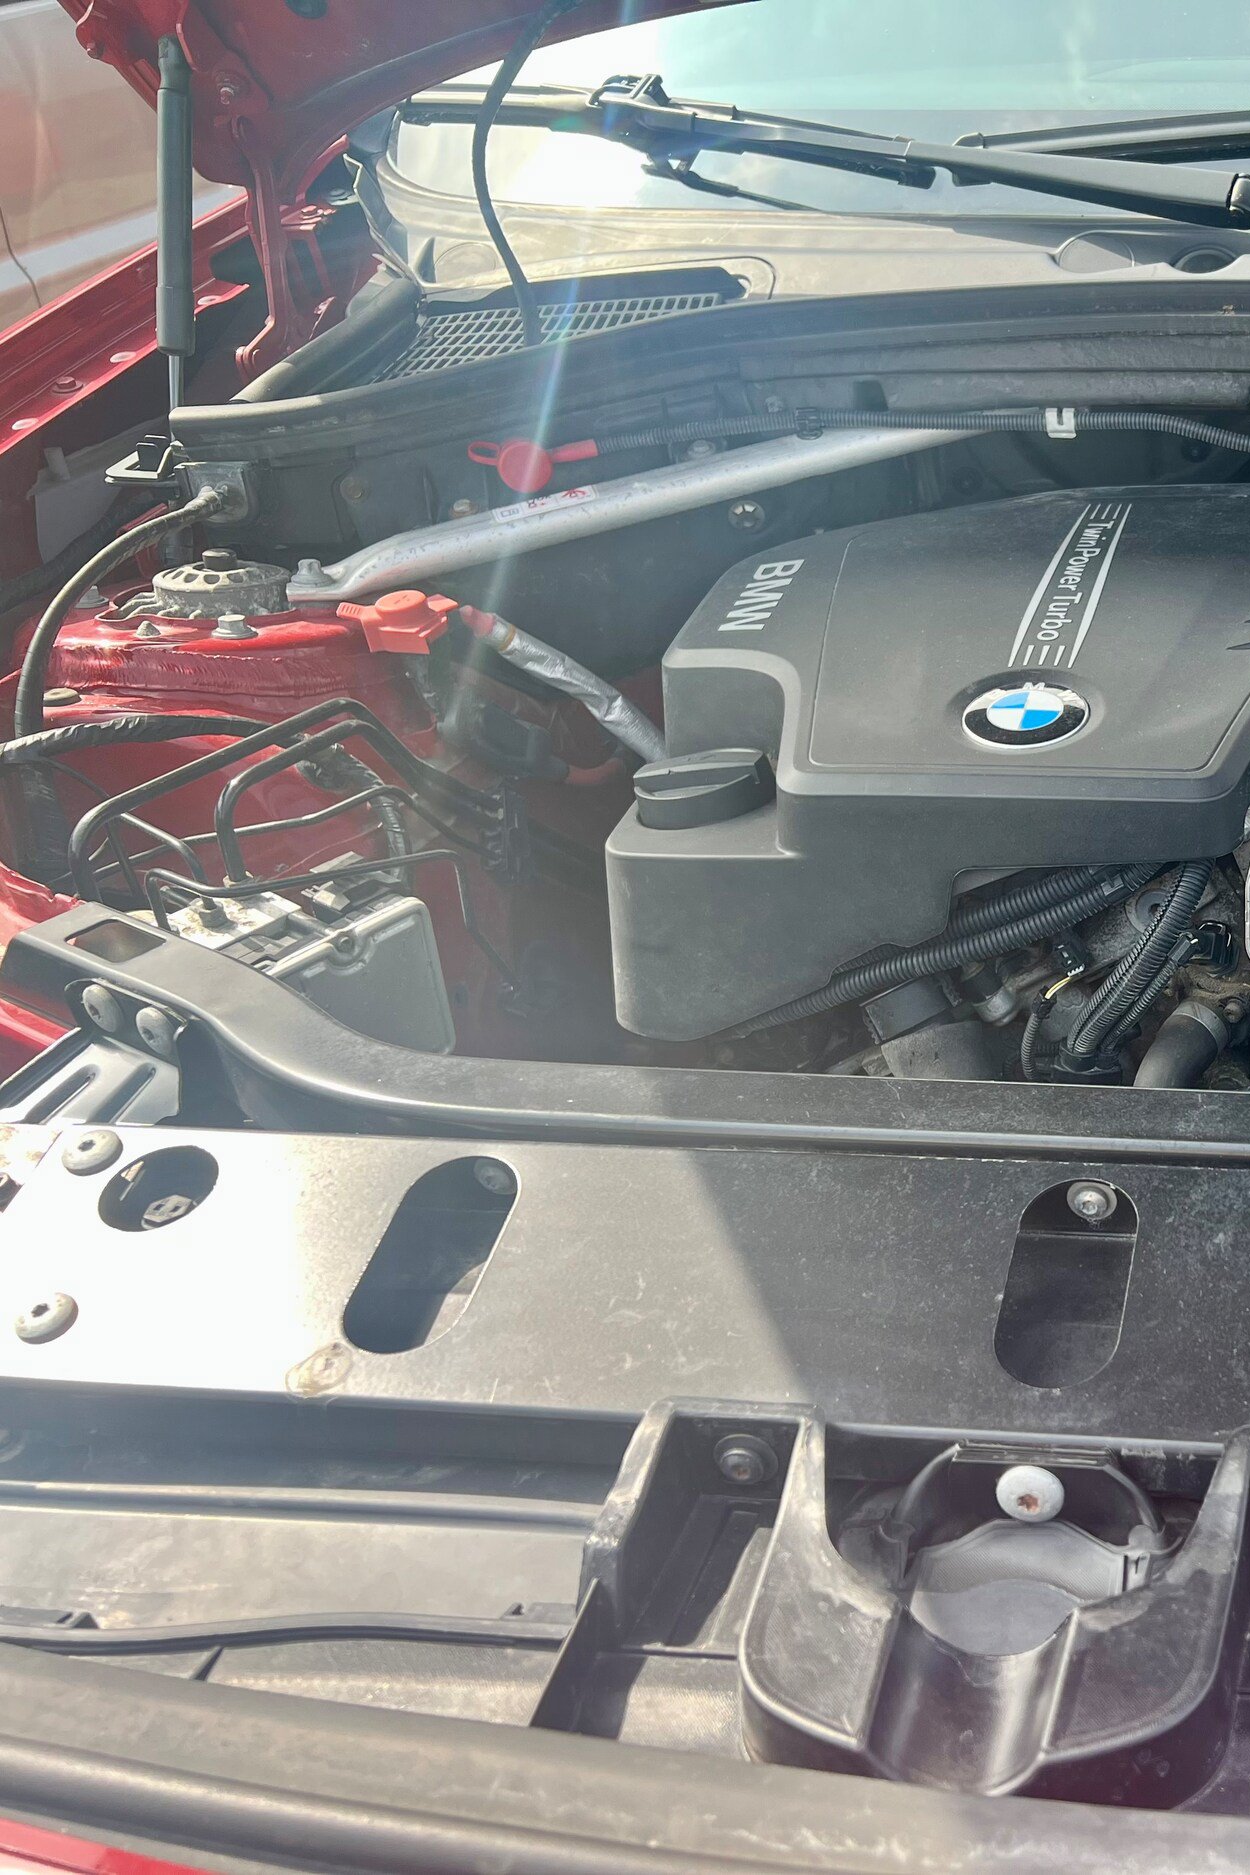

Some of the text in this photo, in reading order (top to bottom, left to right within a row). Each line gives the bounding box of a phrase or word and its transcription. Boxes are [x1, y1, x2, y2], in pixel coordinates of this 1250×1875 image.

[718, 559, 805, 631] BMW
[1037, 520, 1115, 641] TwinPower Turbo
